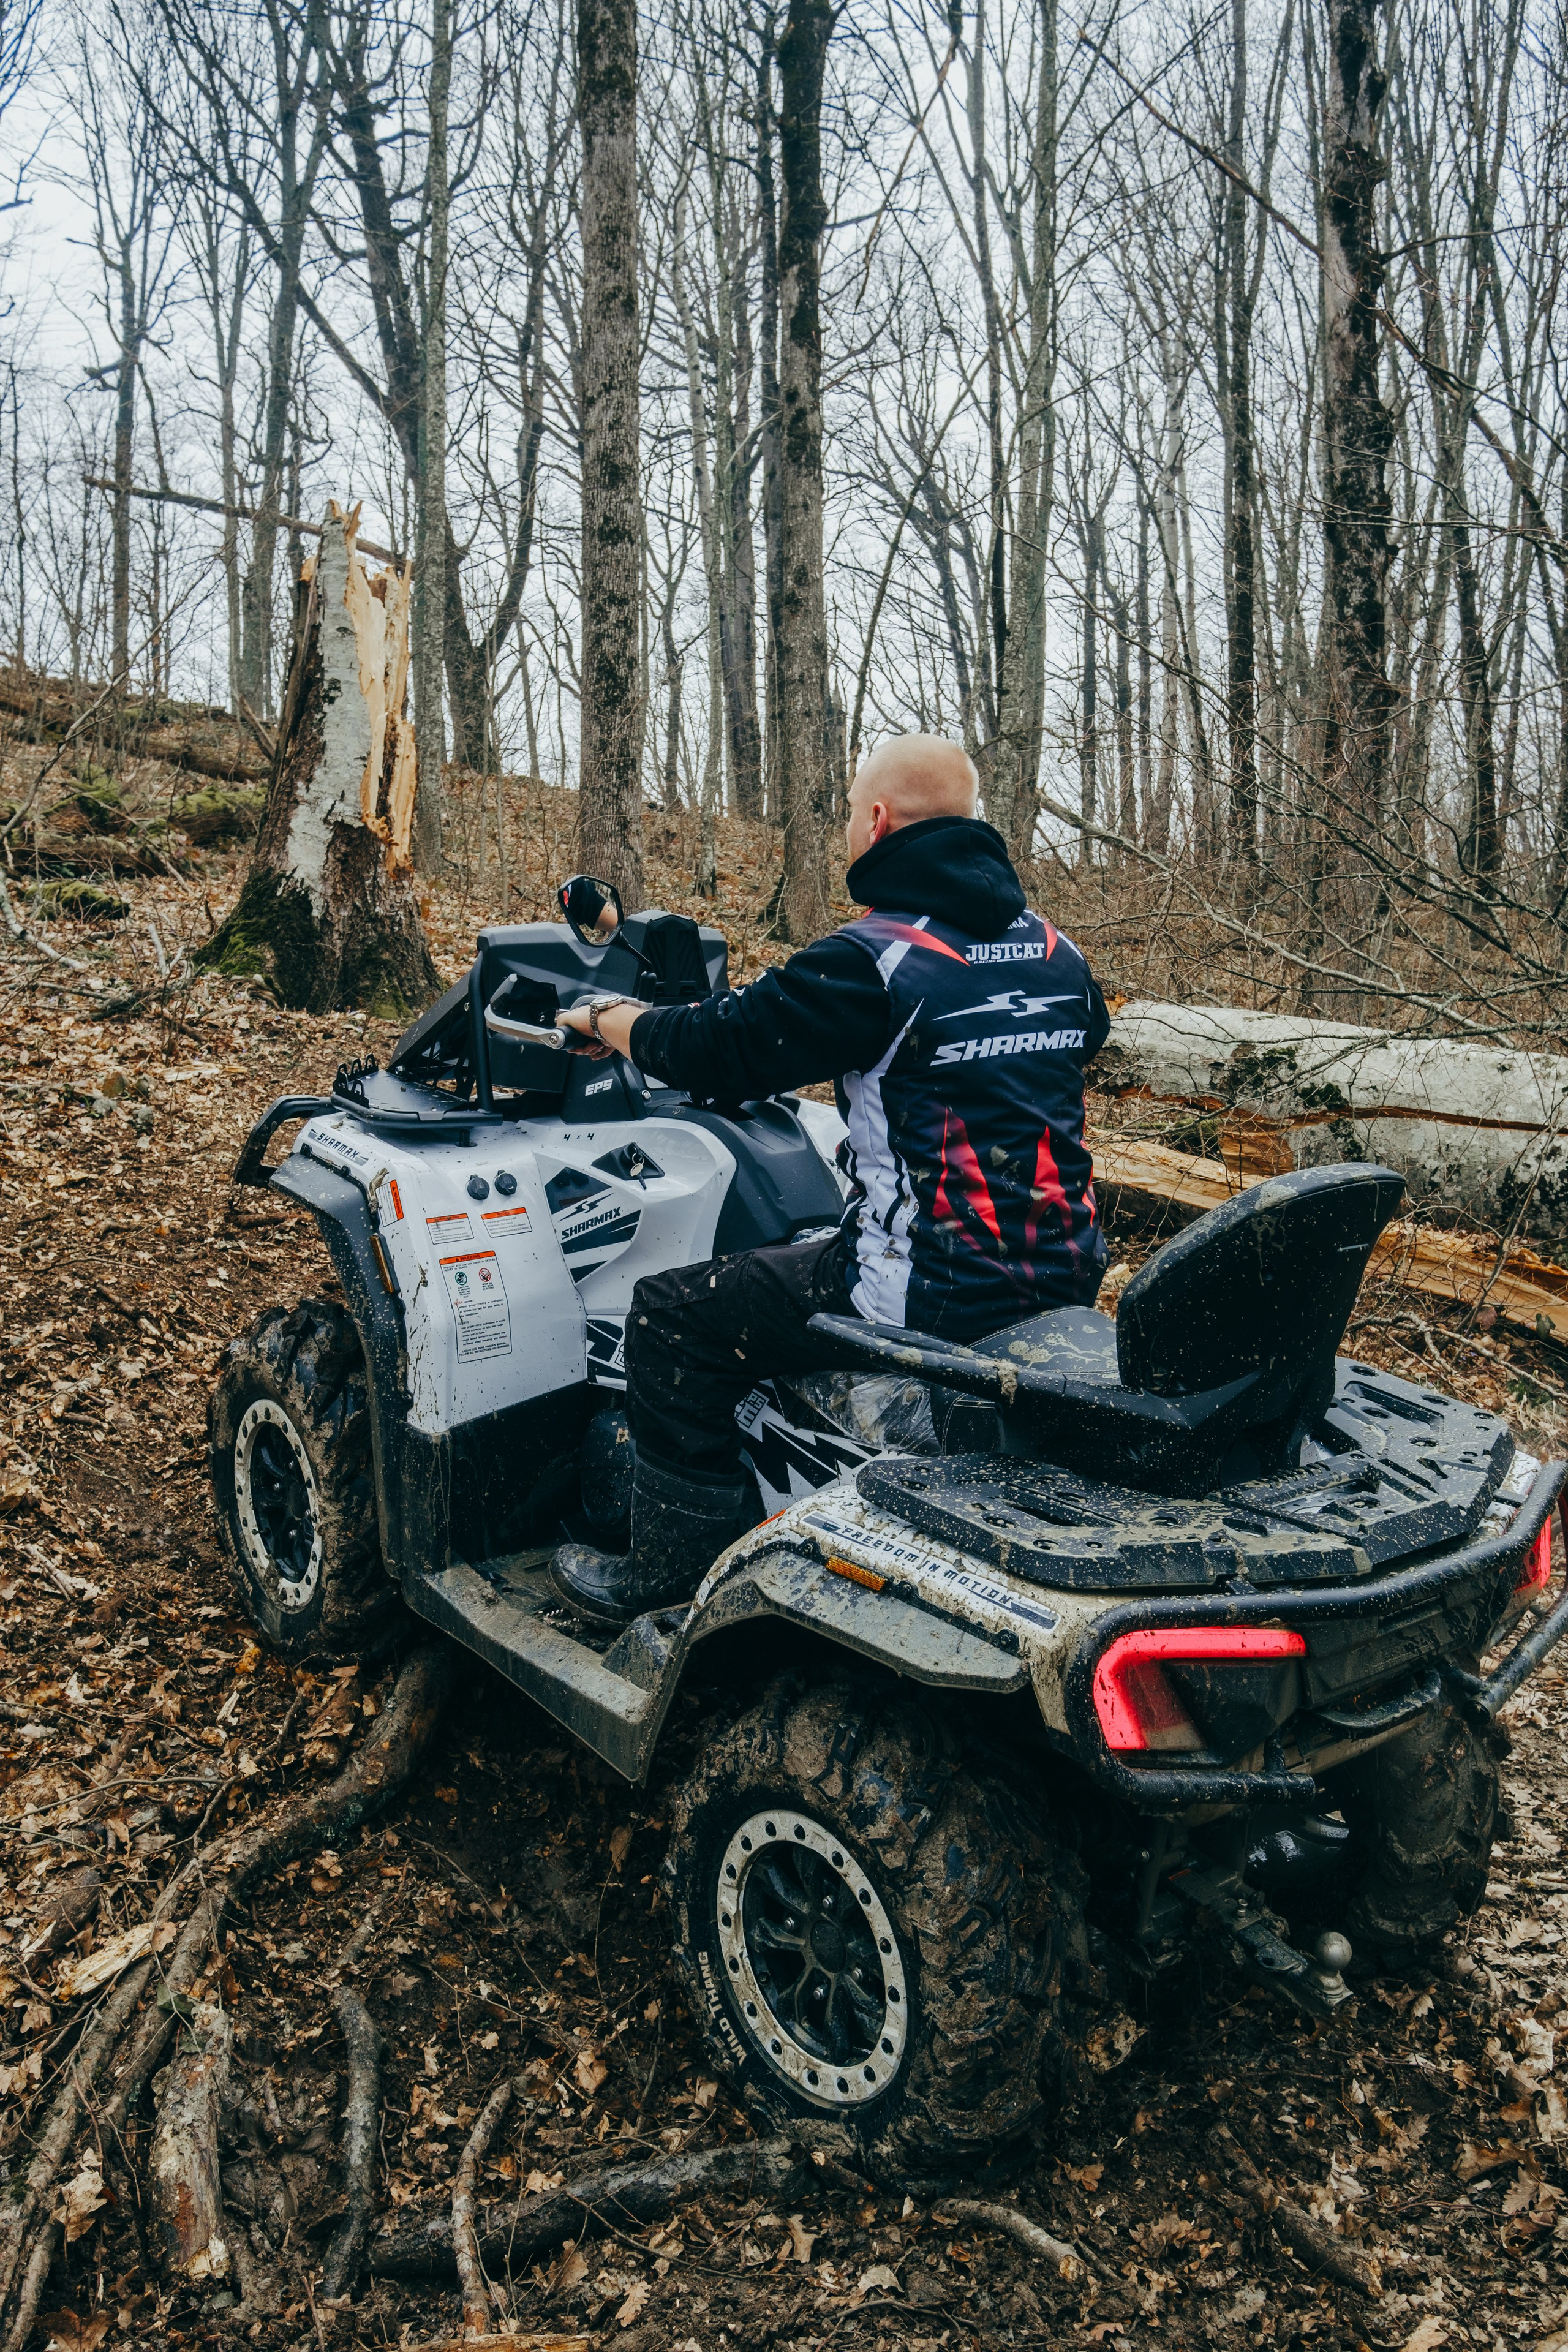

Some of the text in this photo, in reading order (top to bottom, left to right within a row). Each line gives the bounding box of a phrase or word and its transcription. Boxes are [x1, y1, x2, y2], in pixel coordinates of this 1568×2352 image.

[965, 943, 1044, 961] JUSTCAT
[930, 1030, 1087, 1066] SHARMAX
[585, 1079, 614, 1096] EPS
[317, 1132, 360, 1159] SHARMAX
[561, 1206, 621, 1241] SHARMAX
[842, 1526, 1011, 1604] FREEDOM IN MOTION
[698, 1951, 746, 2067] WILD THANG
